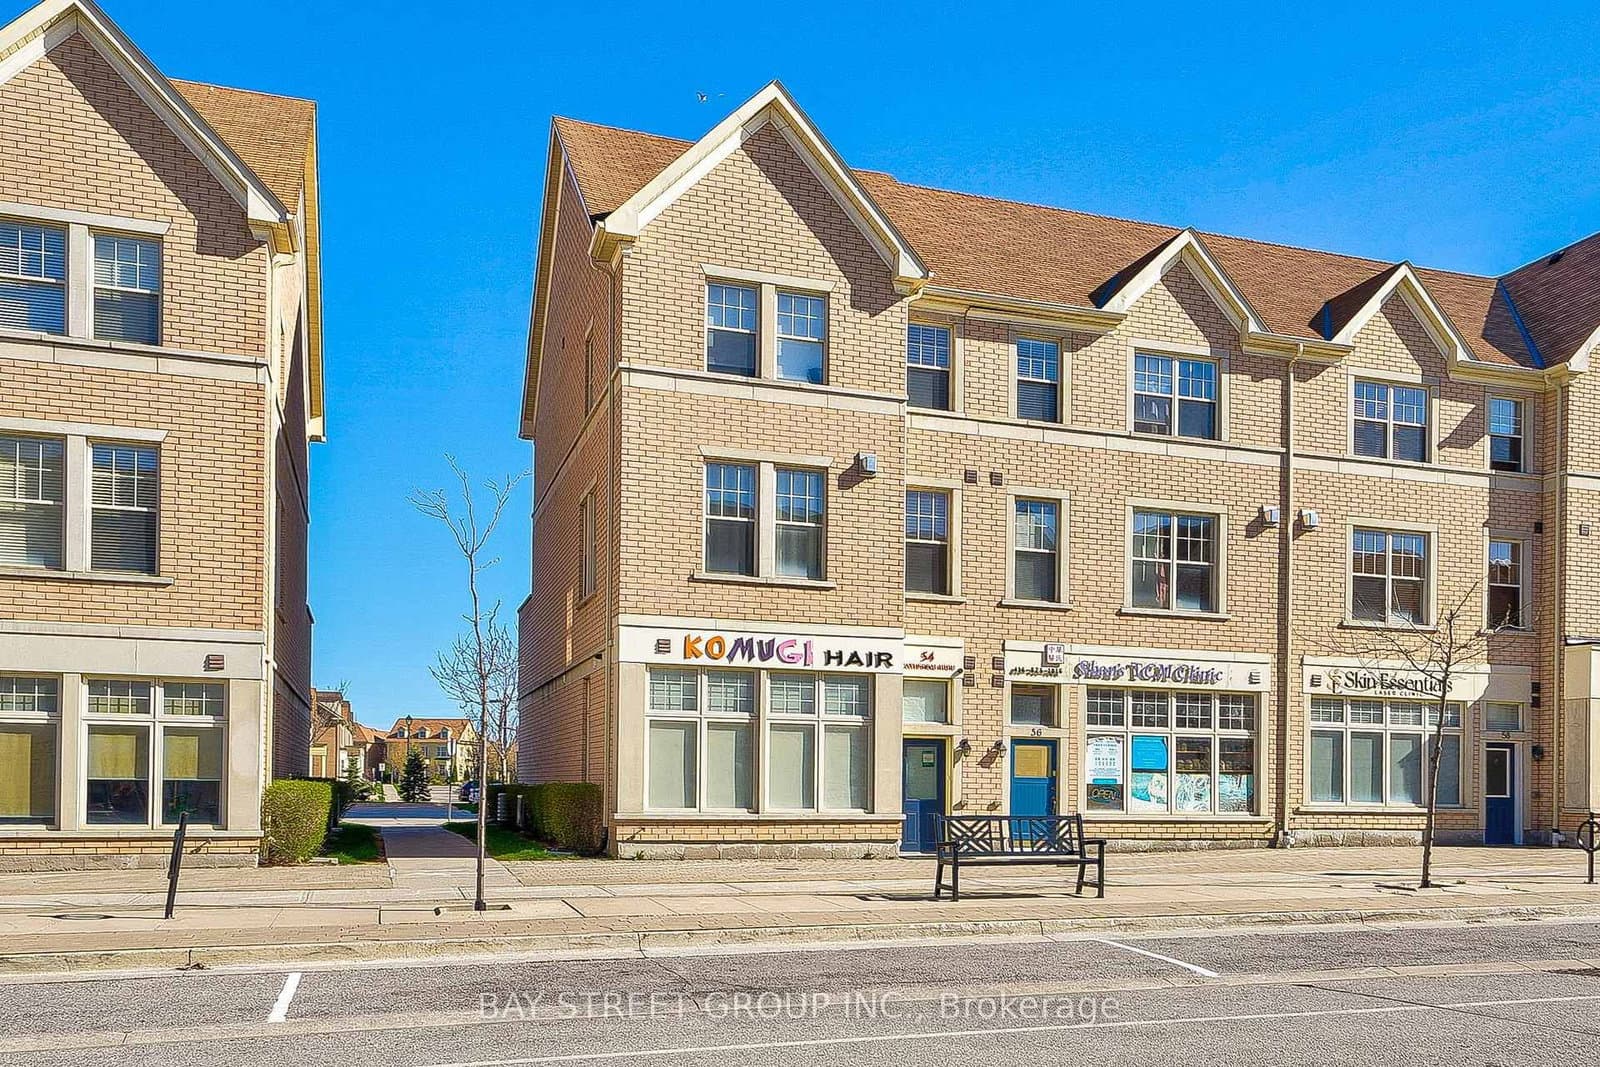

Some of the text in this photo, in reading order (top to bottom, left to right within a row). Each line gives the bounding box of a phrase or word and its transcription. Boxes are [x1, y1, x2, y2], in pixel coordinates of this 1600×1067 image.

[683, 633, 893, 668] KOMUGI HAIR
[1127, 662, 1172, 681] TCM
[1174, 665, 1223, 684] Clinic
[1344, 671, 1453, 692] Skin Essentias
